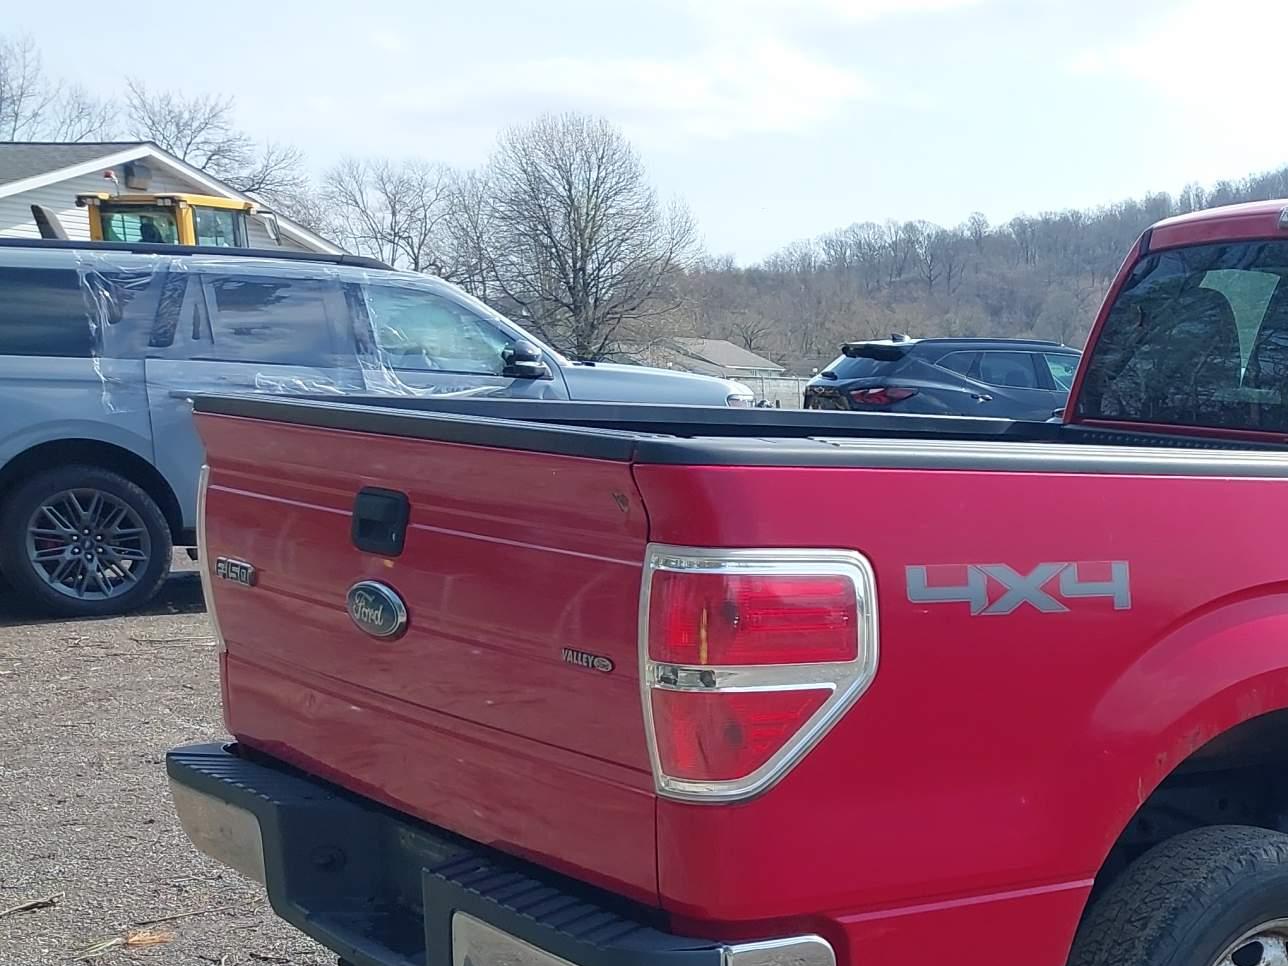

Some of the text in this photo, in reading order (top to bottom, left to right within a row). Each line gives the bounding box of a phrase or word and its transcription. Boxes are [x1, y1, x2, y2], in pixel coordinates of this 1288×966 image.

[905, 560, 1132, 616] 4X4
[352, 590, 384, 626] Ford
[561, 648, 595, 668] VALLEY
